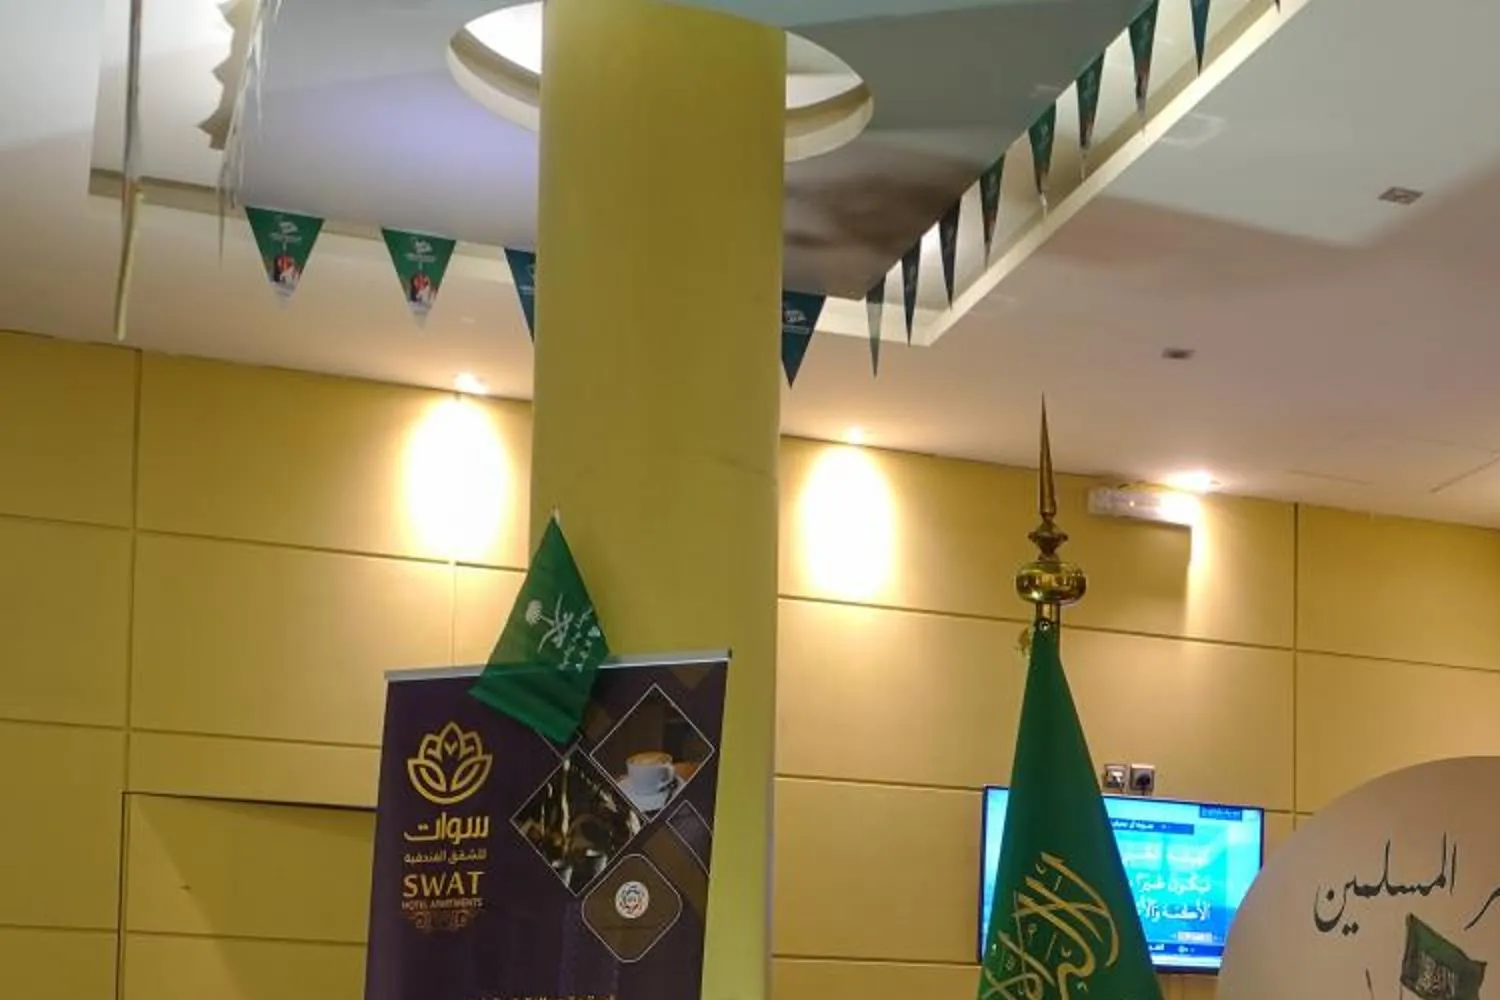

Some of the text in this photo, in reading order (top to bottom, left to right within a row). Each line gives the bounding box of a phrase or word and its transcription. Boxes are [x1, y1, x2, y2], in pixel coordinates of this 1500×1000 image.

[403, 812, 489, 845] سوات
[402, 870, 487, 898] SWAT
[1314, 831, 1458, 936] المسلمين
